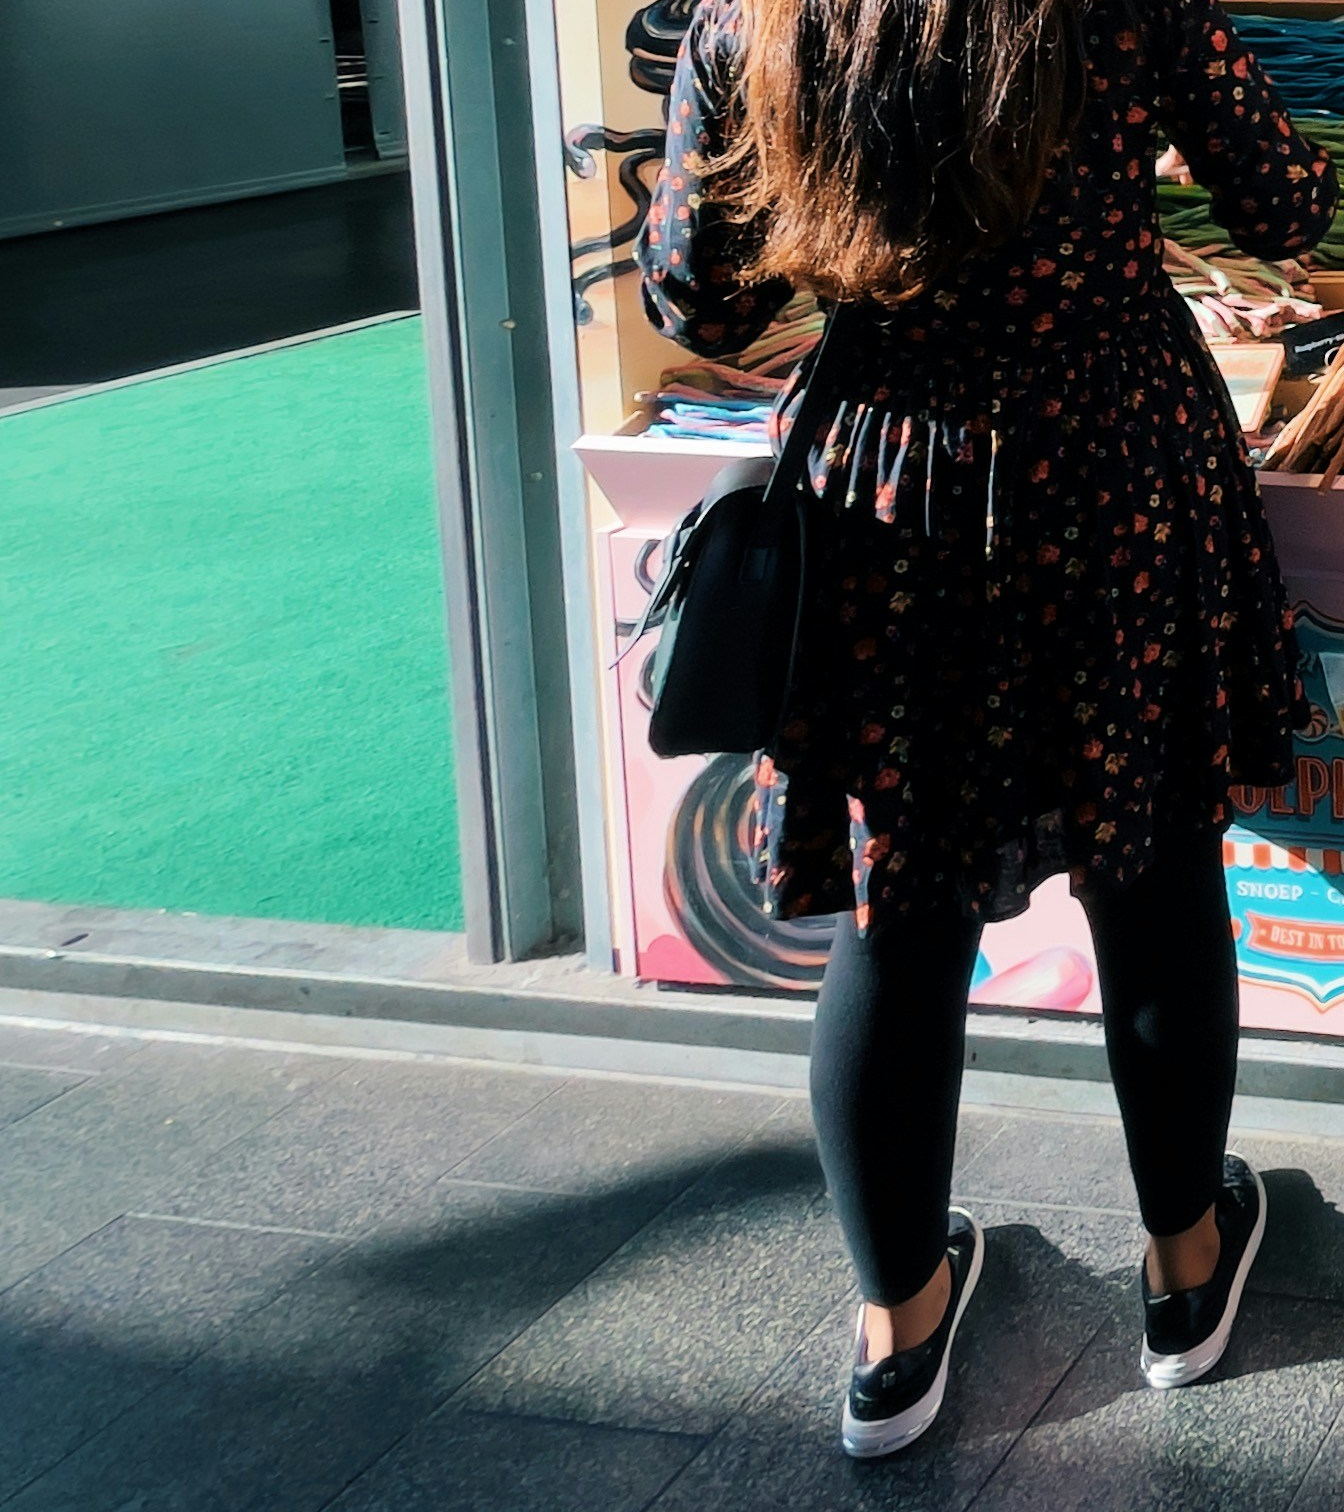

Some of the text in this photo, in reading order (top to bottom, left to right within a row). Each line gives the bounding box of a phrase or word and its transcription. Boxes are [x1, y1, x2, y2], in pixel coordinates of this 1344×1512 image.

[1237, 880, 1303, 900] SNOEP
[1269, 925, 1303, 949] BEST
[1307, 931, 1324, 950] IN
